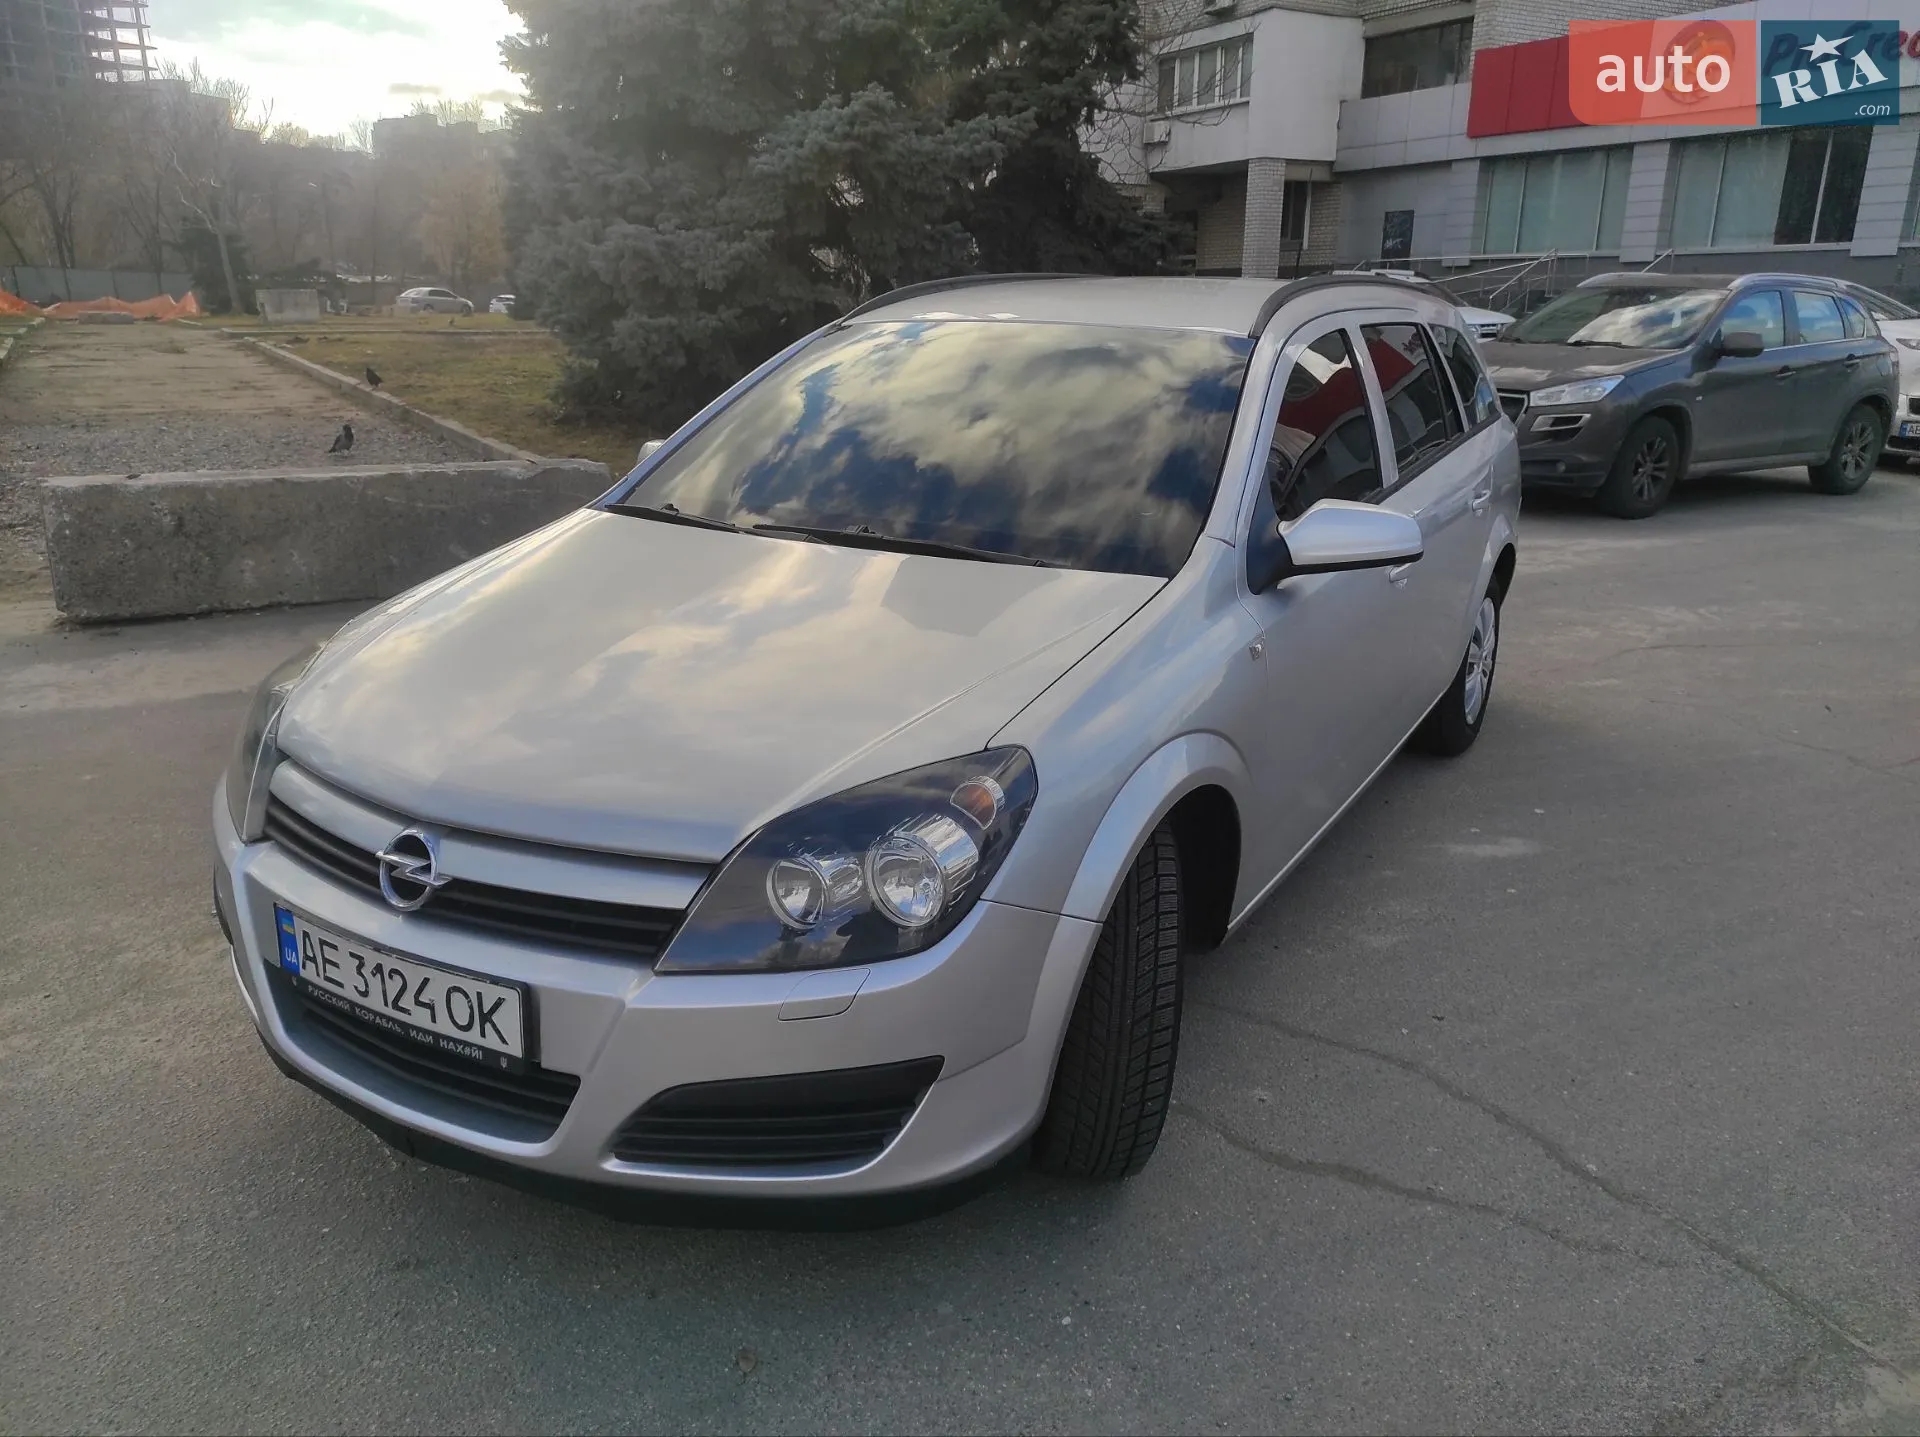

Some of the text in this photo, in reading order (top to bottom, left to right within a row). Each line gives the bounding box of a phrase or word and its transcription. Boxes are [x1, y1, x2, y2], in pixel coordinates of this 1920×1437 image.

[285, 946, 298, 966] UA
[301, 930, 509, 1046] AE 3124 OK
[307, 984, 351, 1012] РУССКИЙ
[409, 1028, 434, 1045] ИДИ
